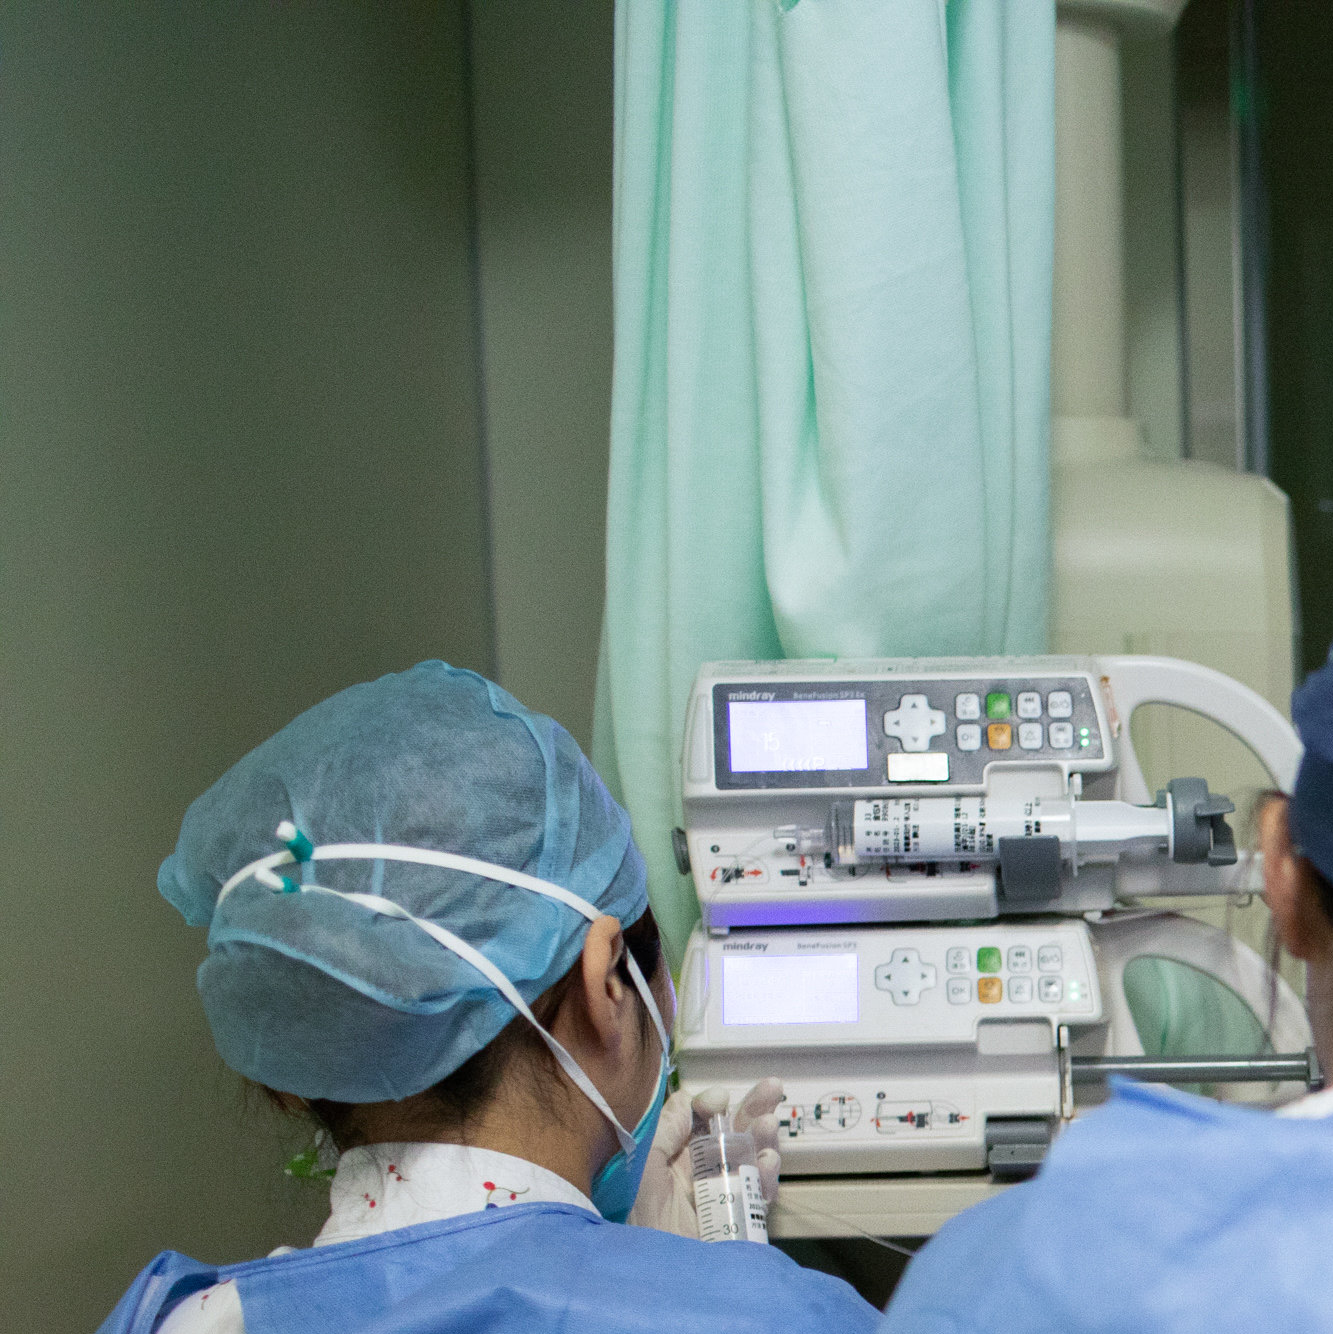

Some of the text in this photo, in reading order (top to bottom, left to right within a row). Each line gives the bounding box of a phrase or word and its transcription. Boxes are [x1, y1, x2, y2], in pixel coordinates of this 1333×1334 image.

[728, 690, 776, 701] mindray
[723, 942, 769, 952] mindray
[719, 1193, 735, 1205] 20
[723, 1223, 739, 1236] 30
